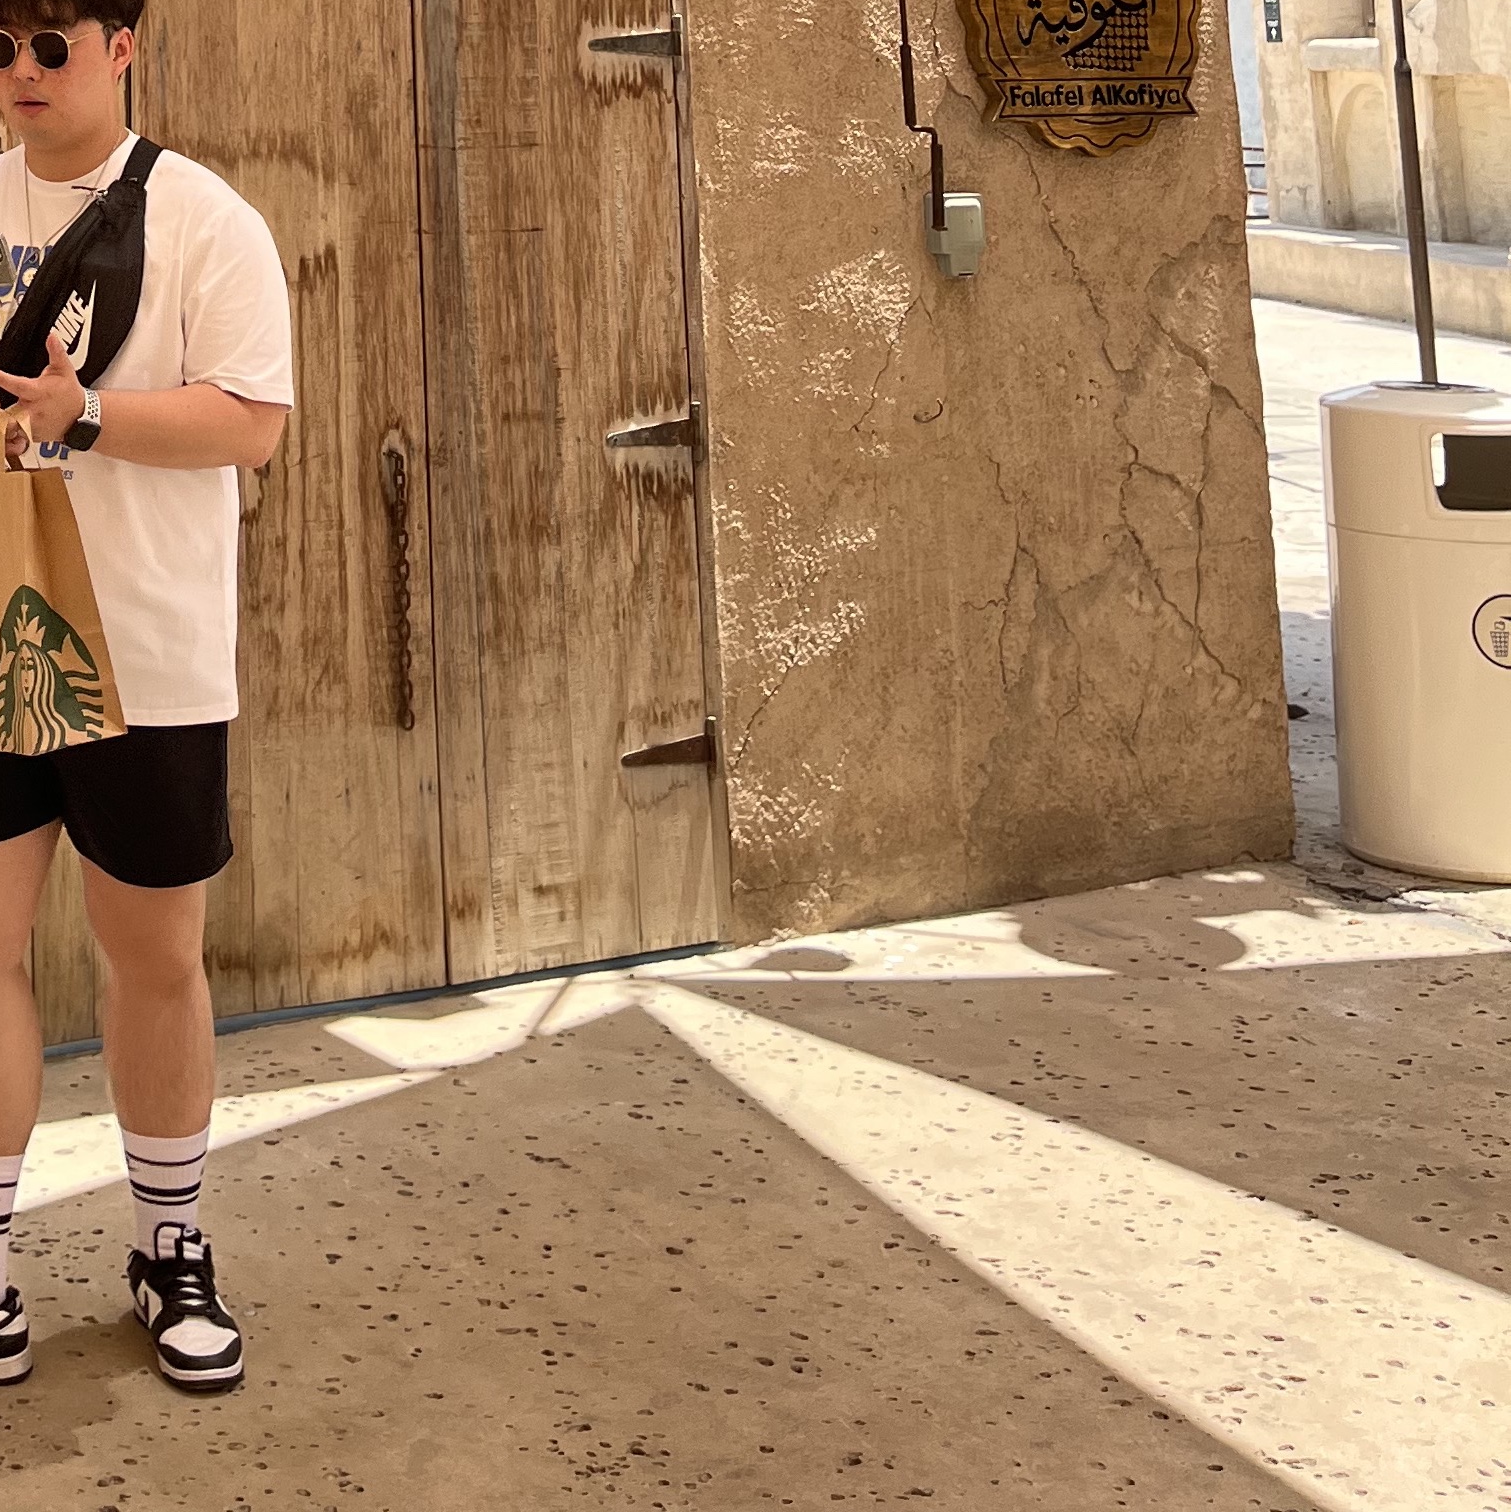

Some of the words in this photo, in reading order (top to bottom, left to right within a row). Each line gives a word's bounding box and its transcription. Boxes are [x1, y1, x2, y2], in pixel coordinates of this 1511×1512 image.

[1009, 84, 1084, 108] Falafel
[1091, 82, 1182, 109] AlKofiya
[49, 289, 90, 352] NIKE
